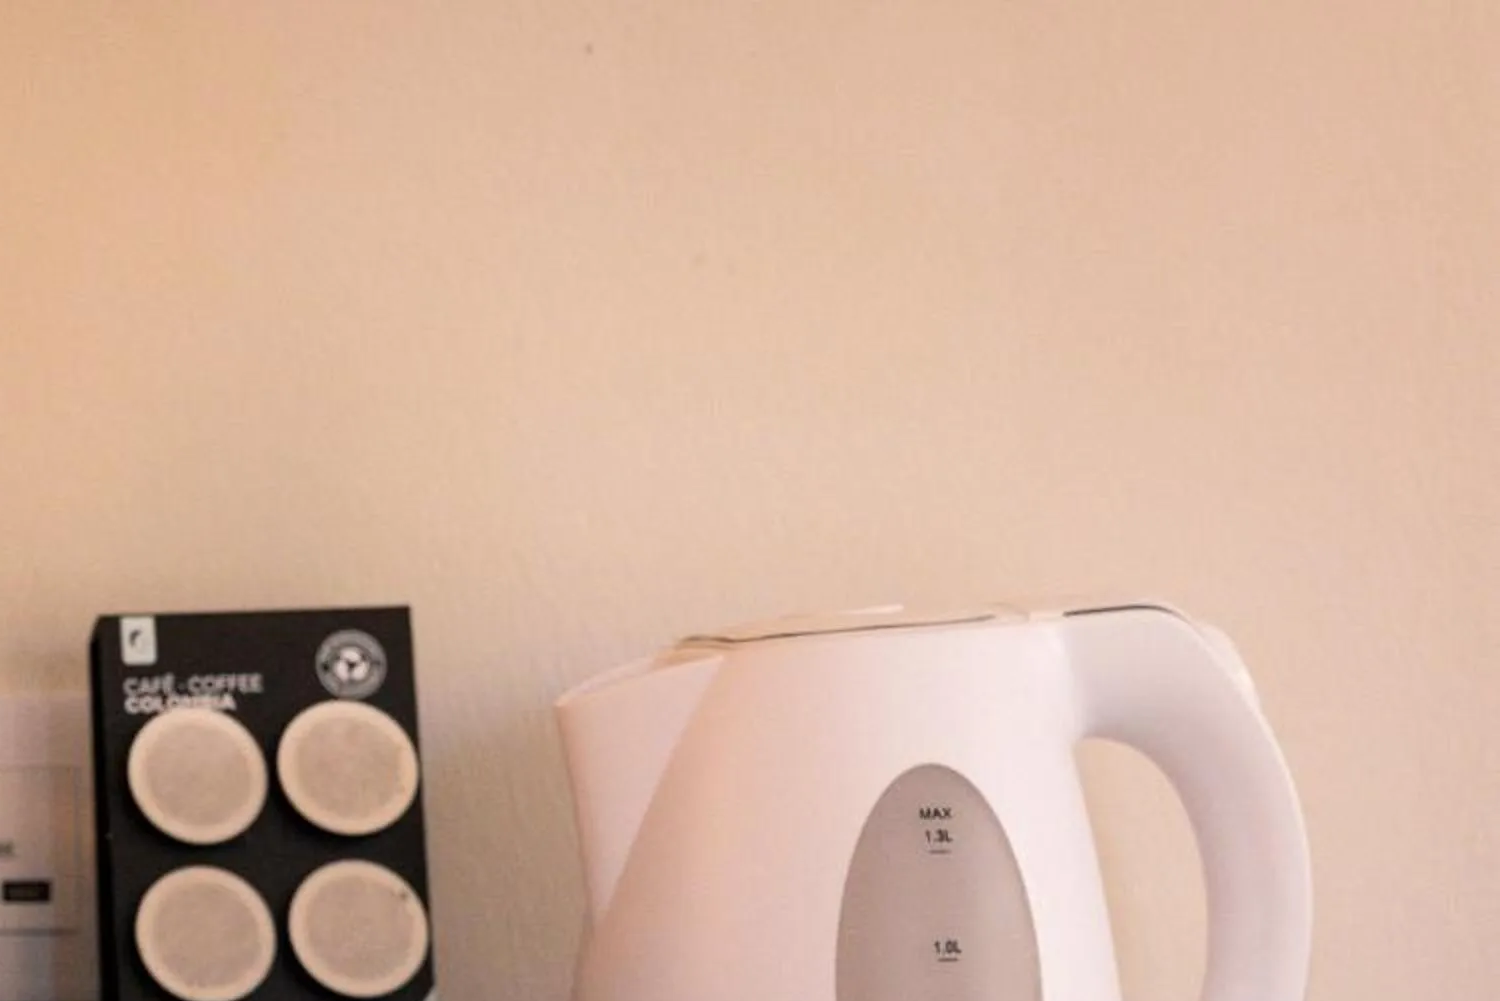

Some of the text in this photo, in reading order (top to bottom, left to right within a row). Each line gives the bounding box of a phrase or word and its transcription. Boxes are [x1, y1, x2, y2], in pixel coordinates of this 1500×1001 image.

[188, 672, 263, 694] COFFEE
[919, 808, 952, 820] MAX
[925, 829, 953, 843] 1.3L
[934, 940, 961, 954] 1.0L
